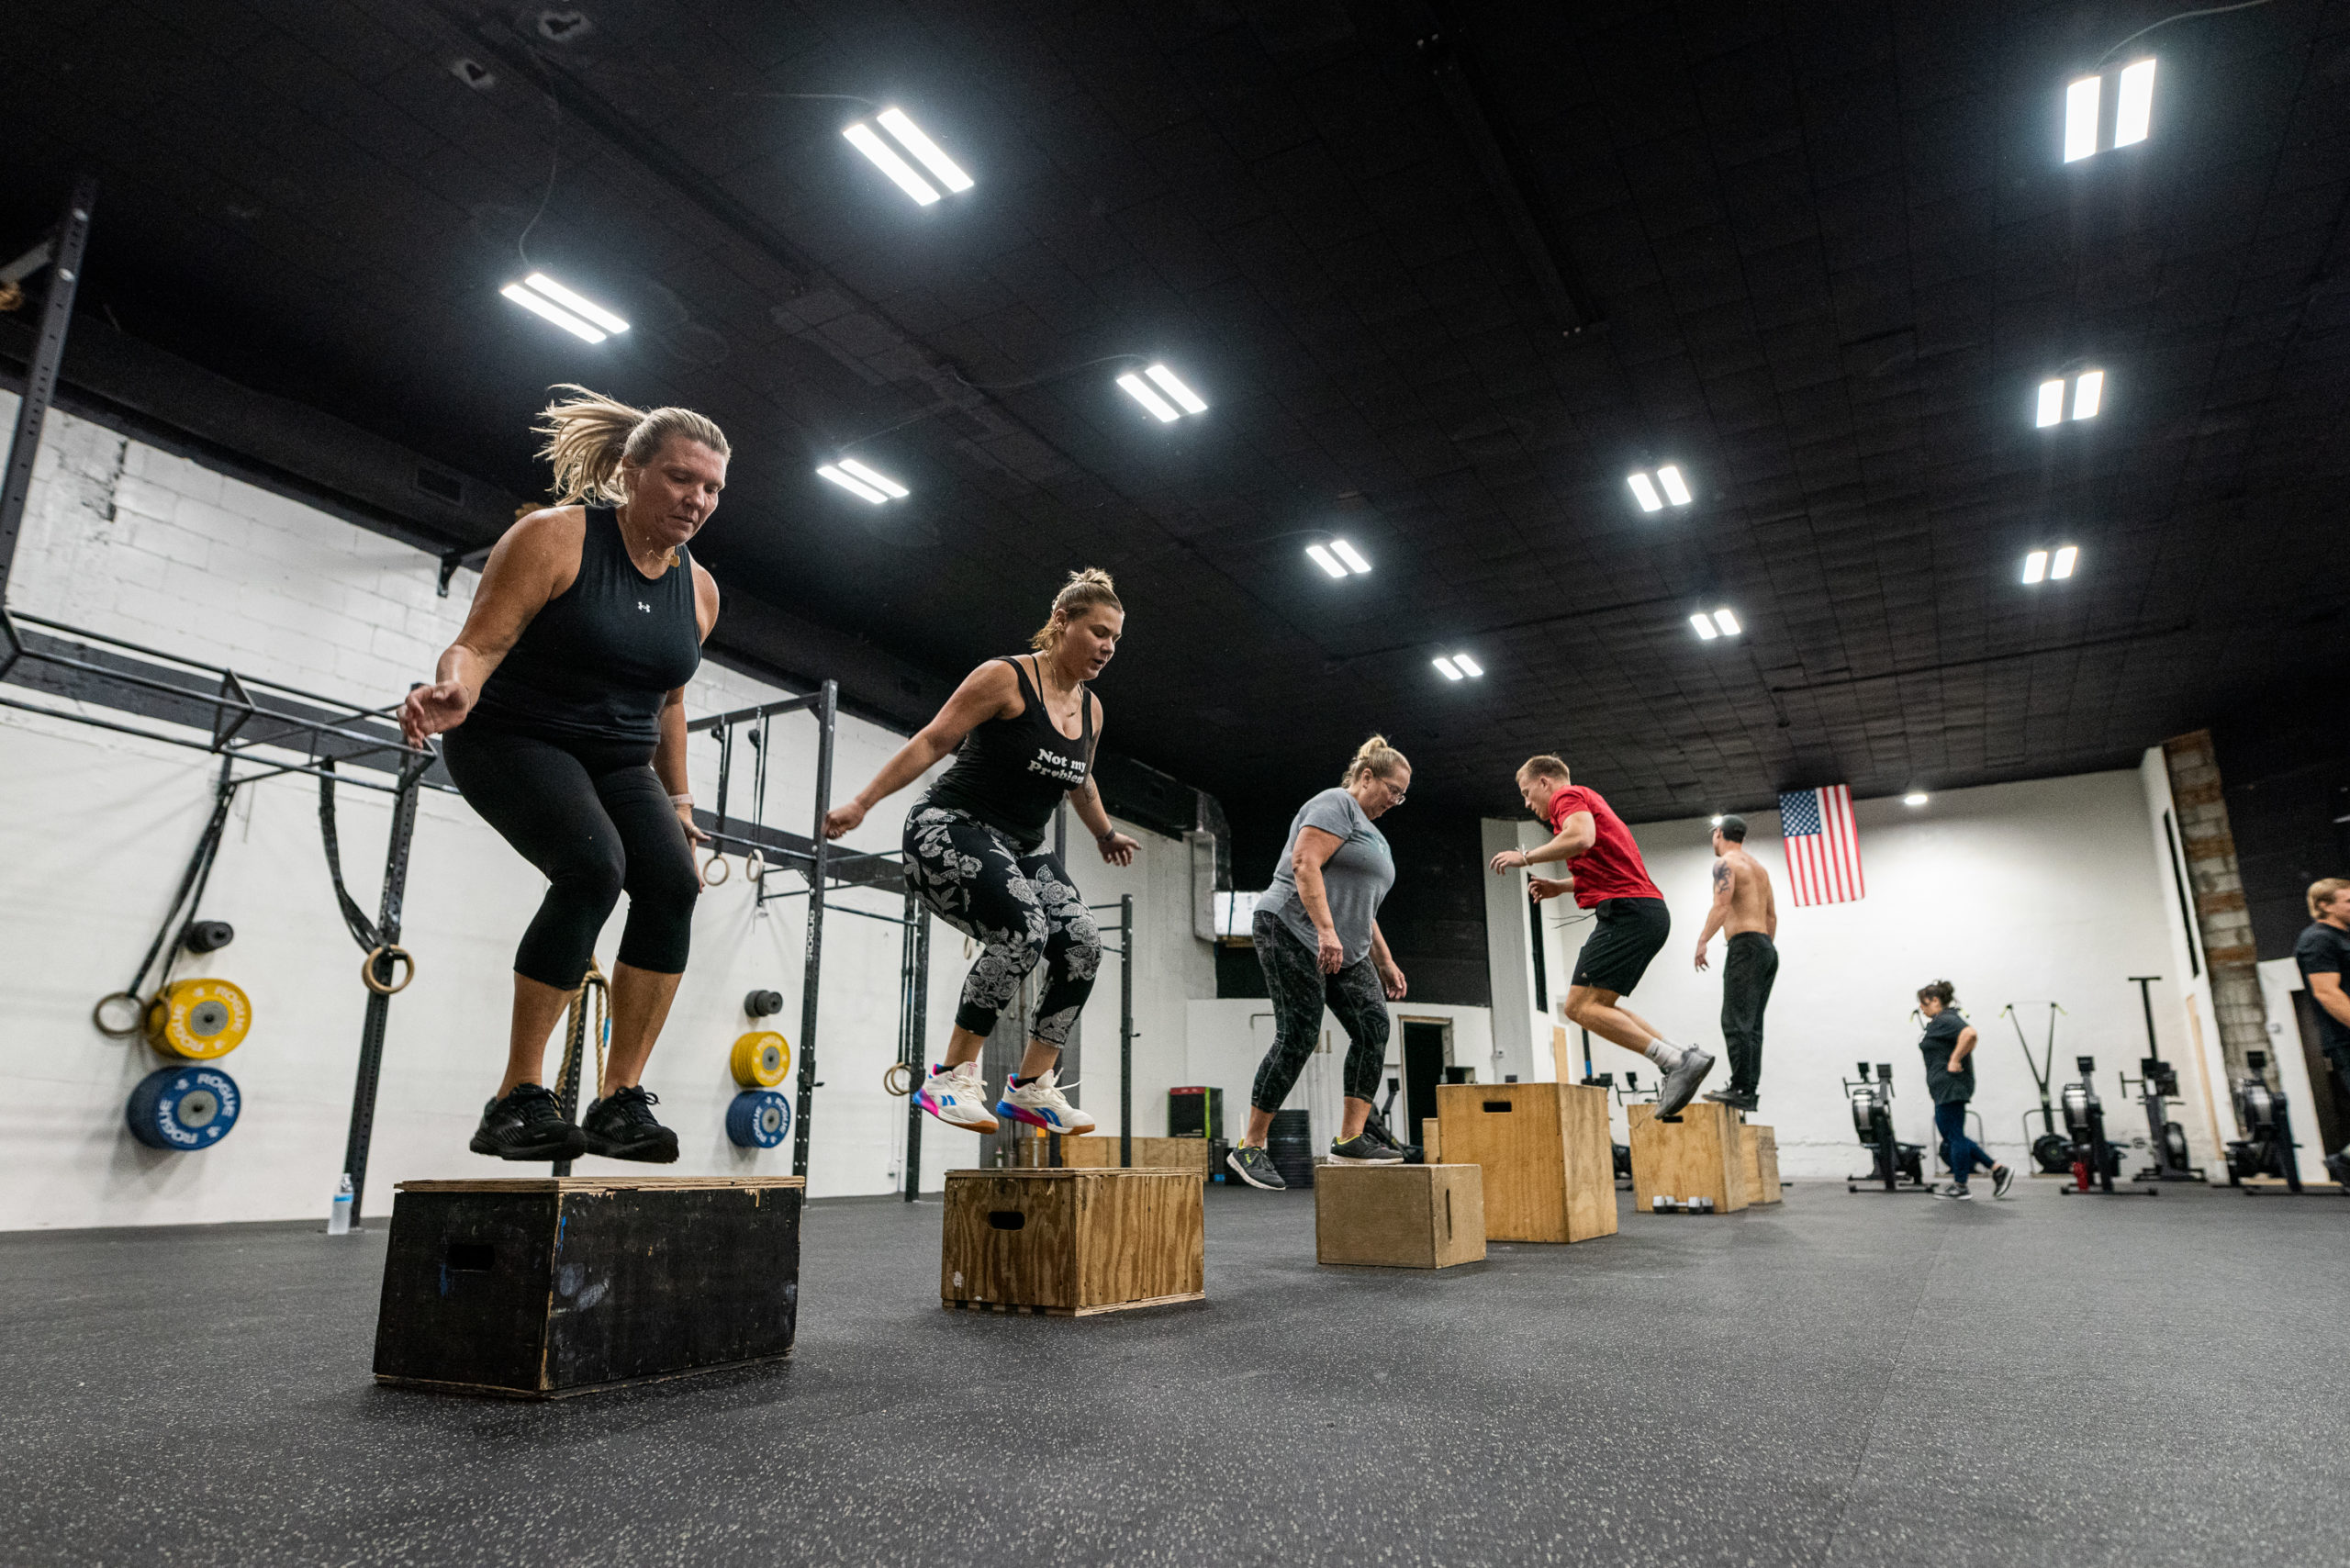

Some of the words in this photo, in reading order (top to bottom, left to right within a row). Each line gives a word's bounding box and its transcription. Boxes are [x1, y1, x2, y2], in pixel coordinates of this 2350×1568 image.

[1037, 748, 1068, 767] Not
[1070, 760, 1086, 773] my
[172, 1004, 205, 1052] ROGUE
[215, 986, 245, 1033] ROGUE
[197, 1073, 236, 1117] ROGUE
[775, 1097, 789, 1134] ROGUE
[158, 1099, 198, 1144] ROGUE
[753, 1105, 767, 1144] ROGUE
